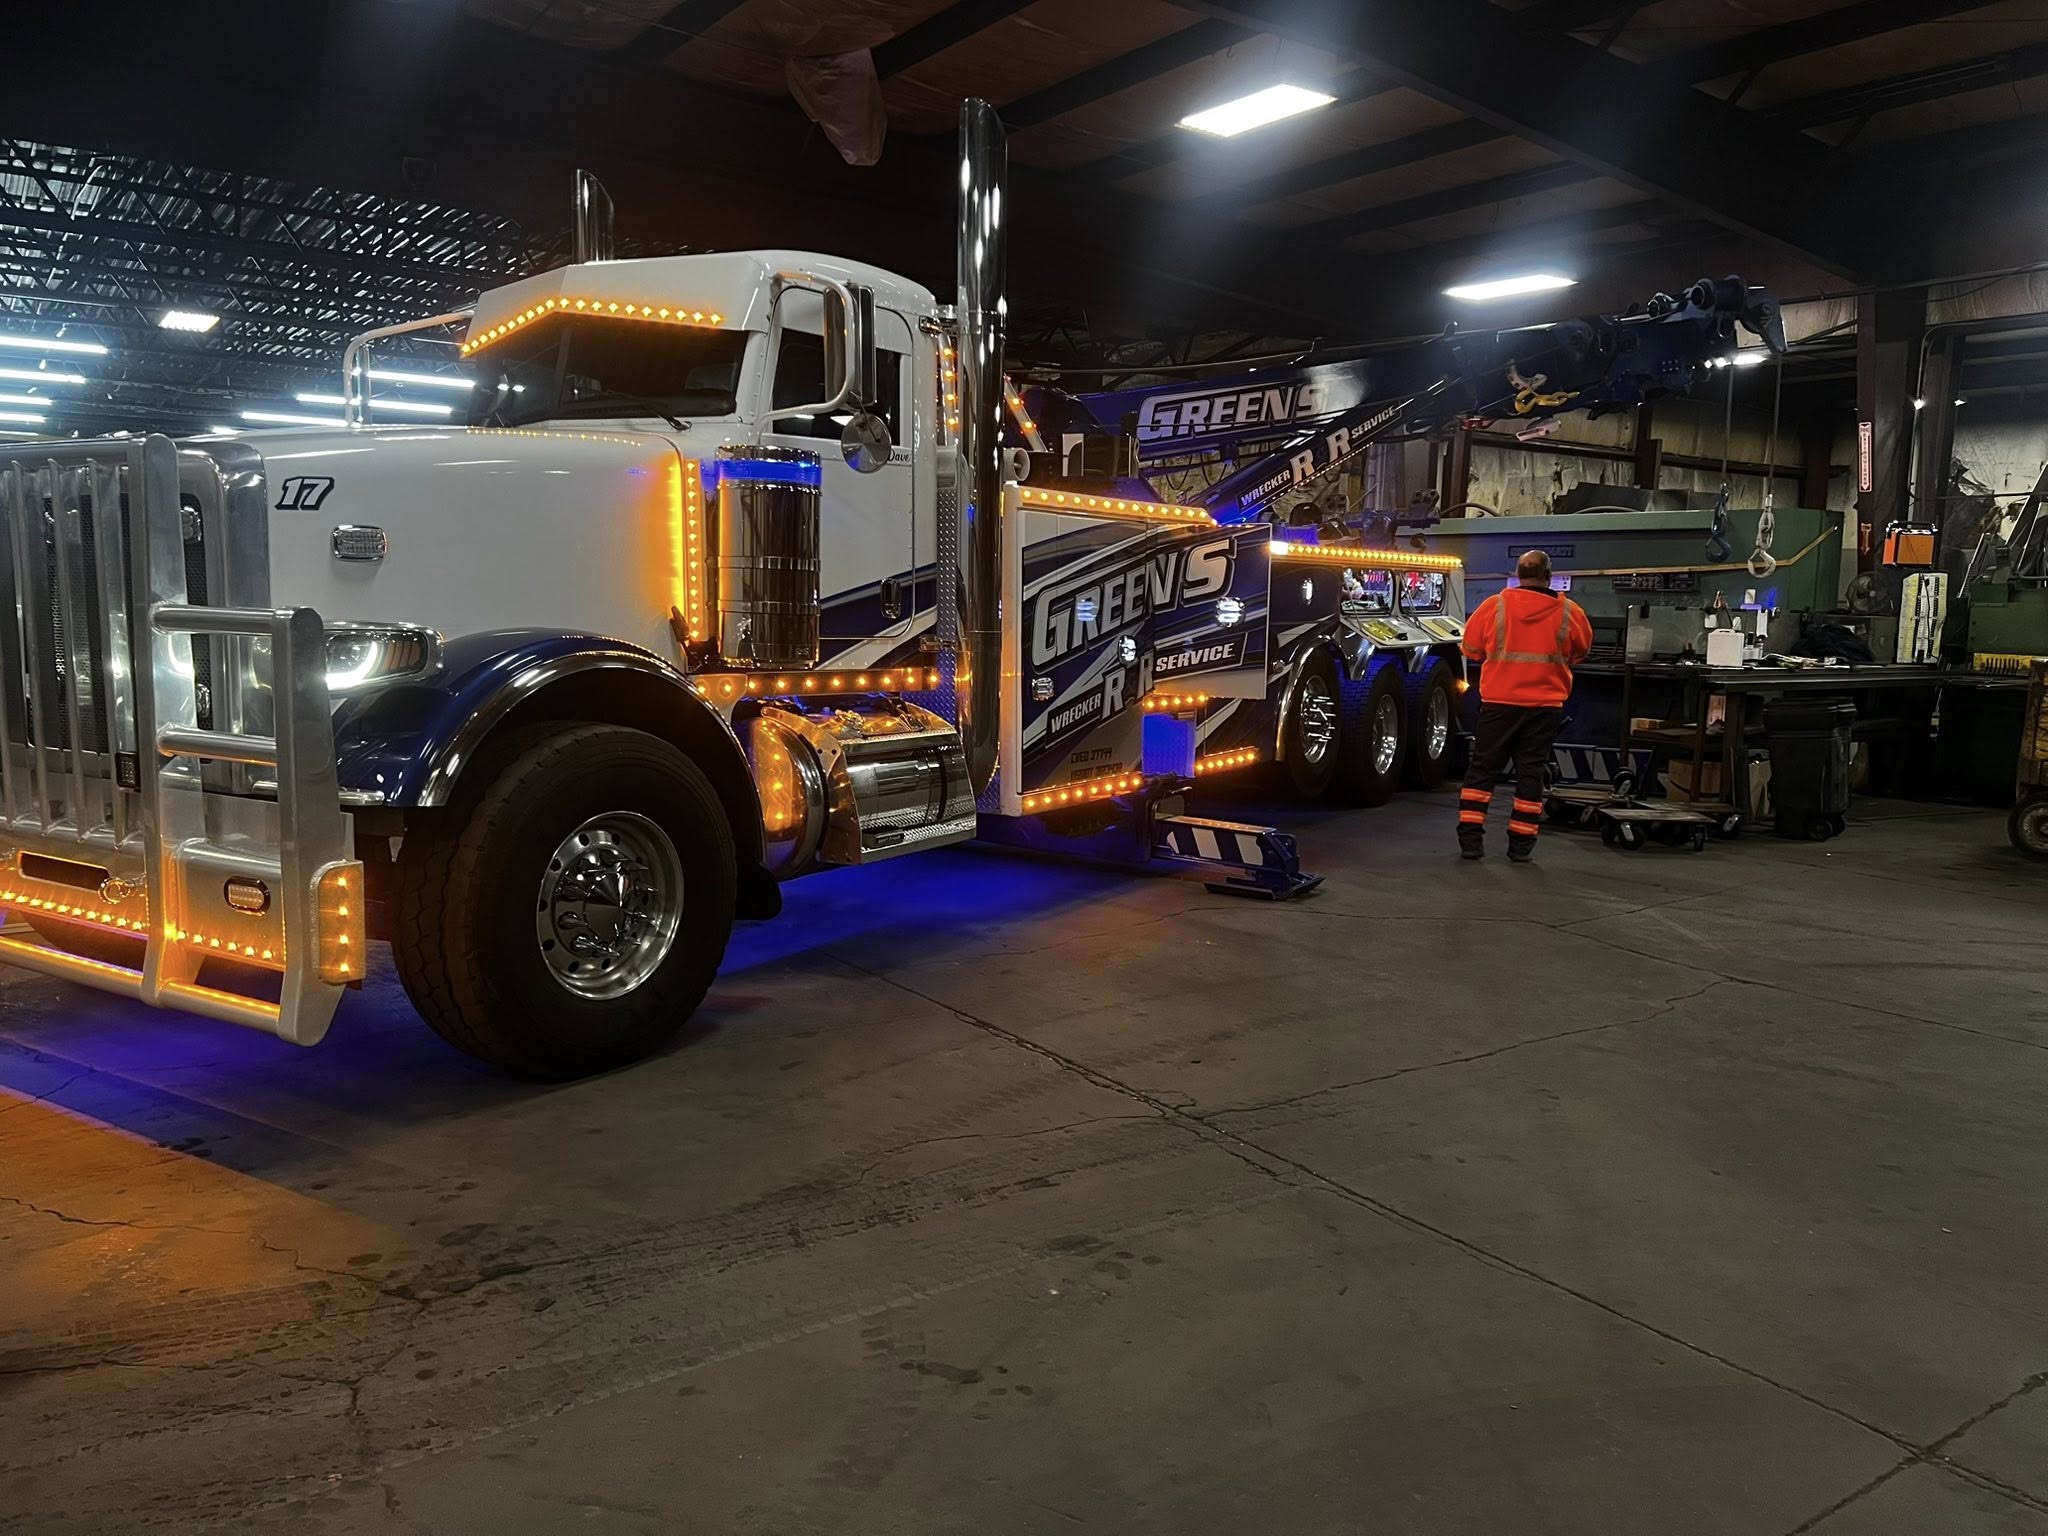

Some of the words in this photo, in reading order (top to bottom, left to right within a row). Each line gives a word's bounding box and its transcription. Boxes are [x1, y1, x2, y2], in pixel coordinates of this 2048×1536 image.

[1136, 380, 1329, 441] GREENS
[1240, 469, 1290, 506] WRECKER
[1290, 448, 1315, 485] R
[1325, 427, 1351, 463] R
[1351, 405, 1394, 439] SERVICE
[275, 476, 335, 511] 17
[1032, 539, 1230, 666] GREENS
[1051, 693, 1102, 734] WRECKER
[1102, 667, 1126, 720] R
[1155, 642, 1235, 672] SERVICE
